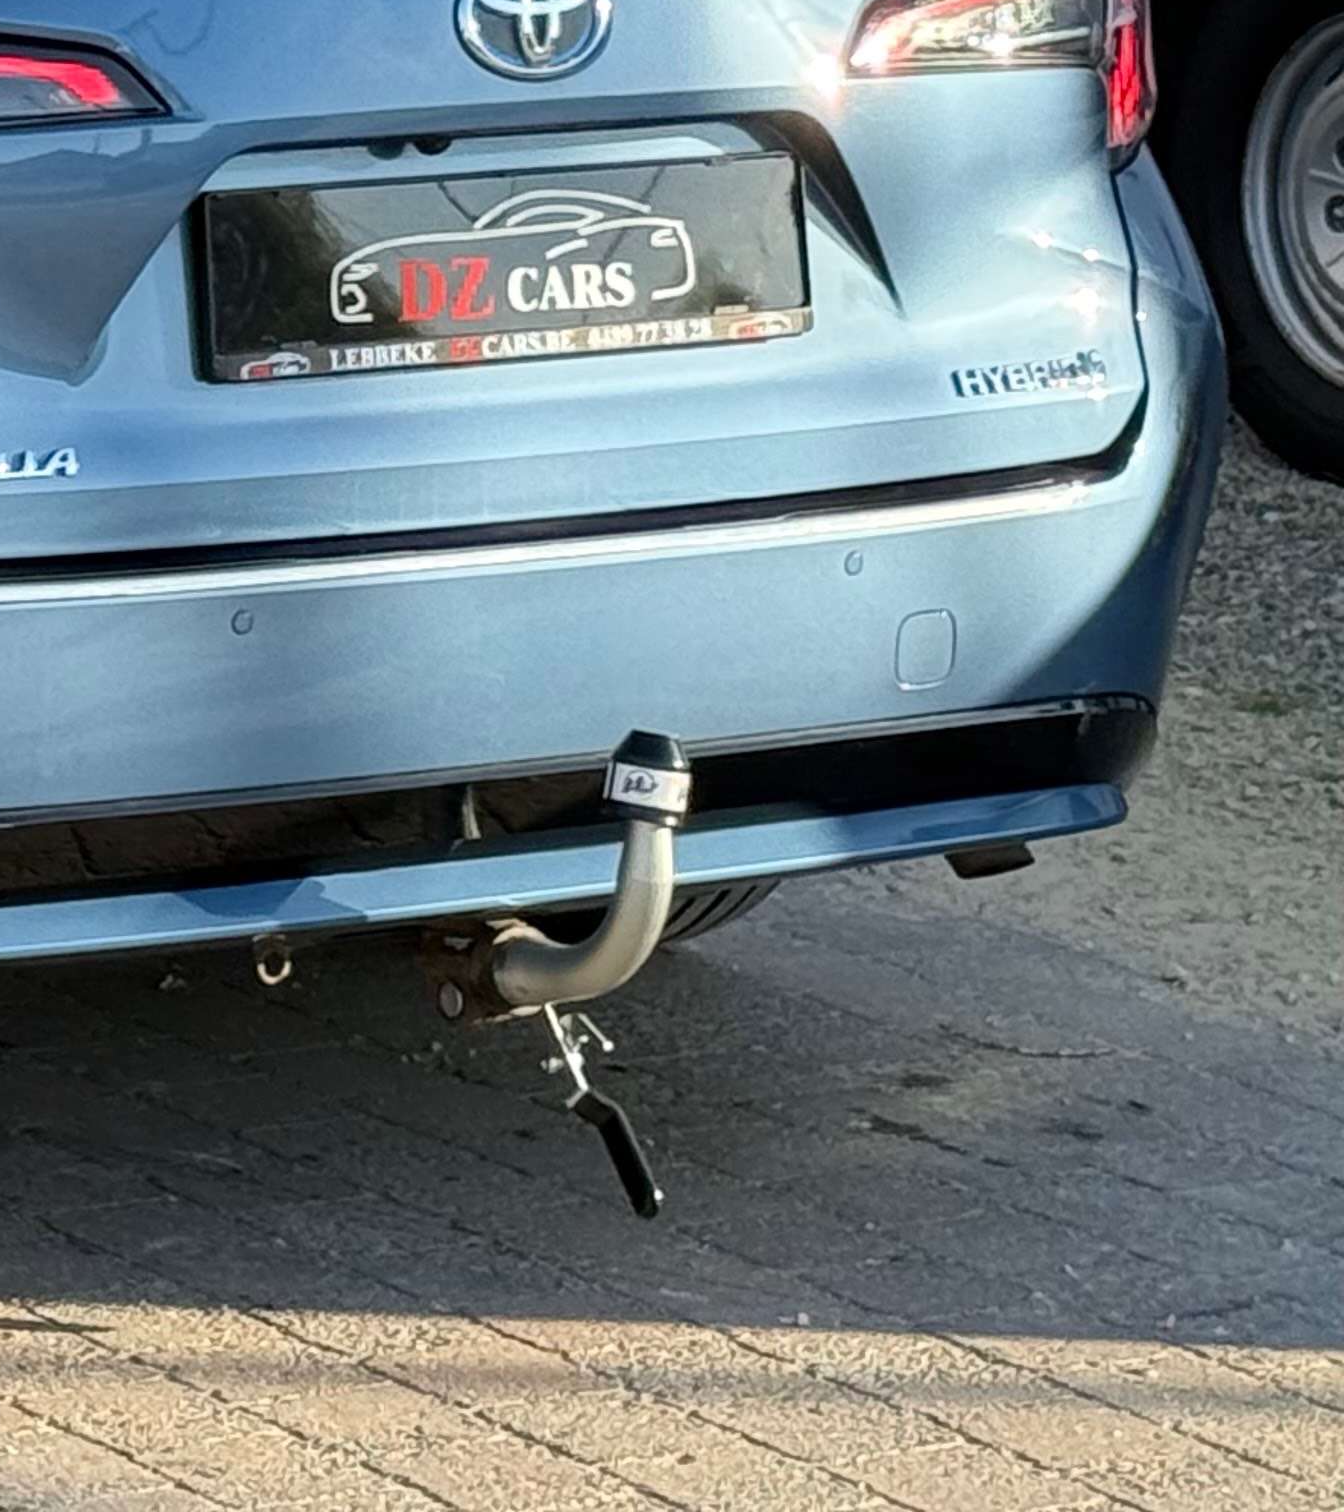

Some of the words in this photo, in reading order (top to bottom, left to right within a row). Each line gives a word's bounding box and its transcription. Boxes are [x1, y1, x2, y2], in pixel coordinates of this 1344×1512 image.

[398, 255, 496, 323] DZ
[507, 262, 635, 312] CARS
[328, 341, 438, 371] LEBBEKE
